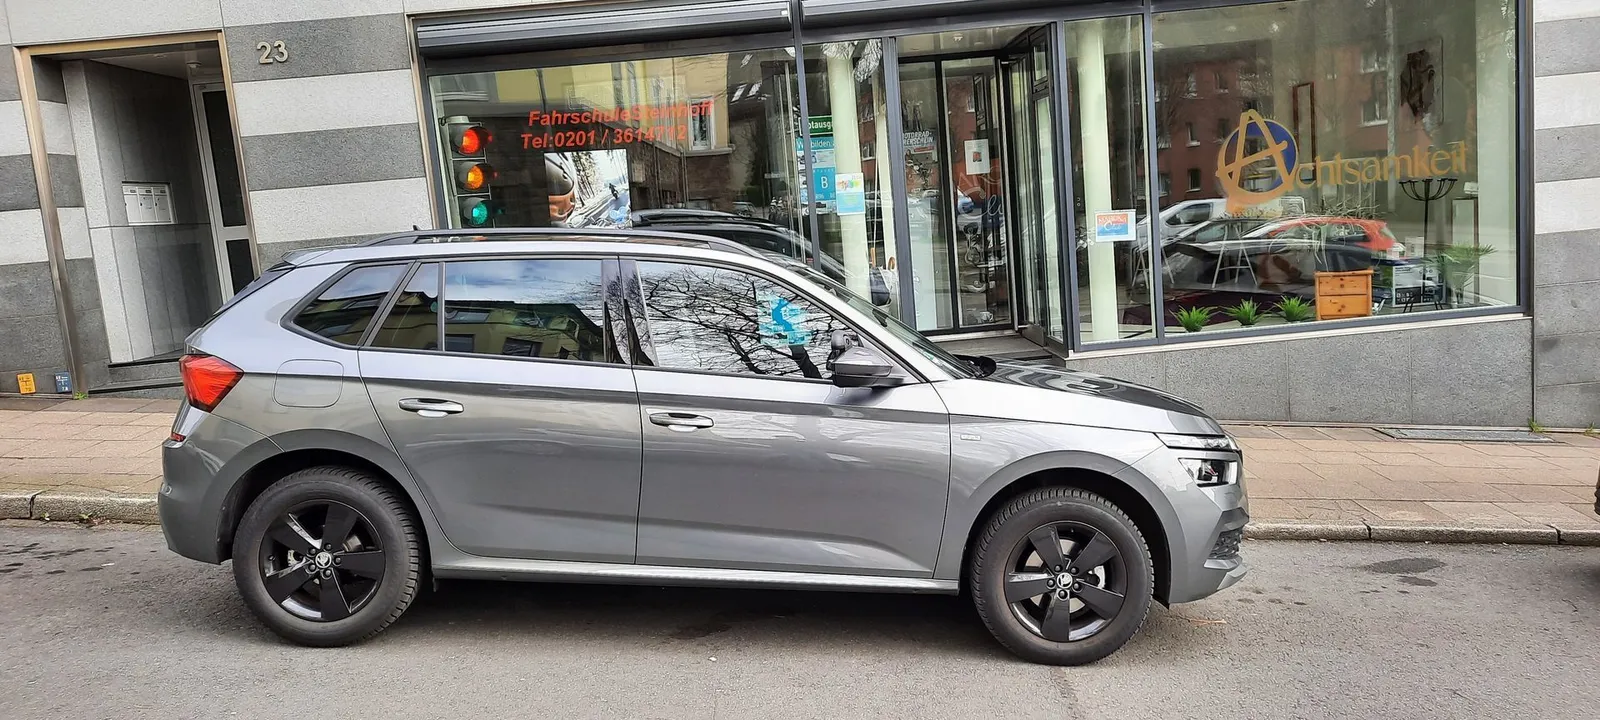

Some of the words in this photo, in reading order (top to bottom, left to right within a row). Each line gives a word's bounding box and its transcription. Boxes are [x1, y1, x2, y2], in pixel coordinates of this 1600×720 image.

[256, 40, 288, 63] 23
[520, 129, 596, 150] Tel:0201
[600, 128, 609, 145] /
[613, 124, 687, 145] 3614712
[820, 176, 829, 189] B
